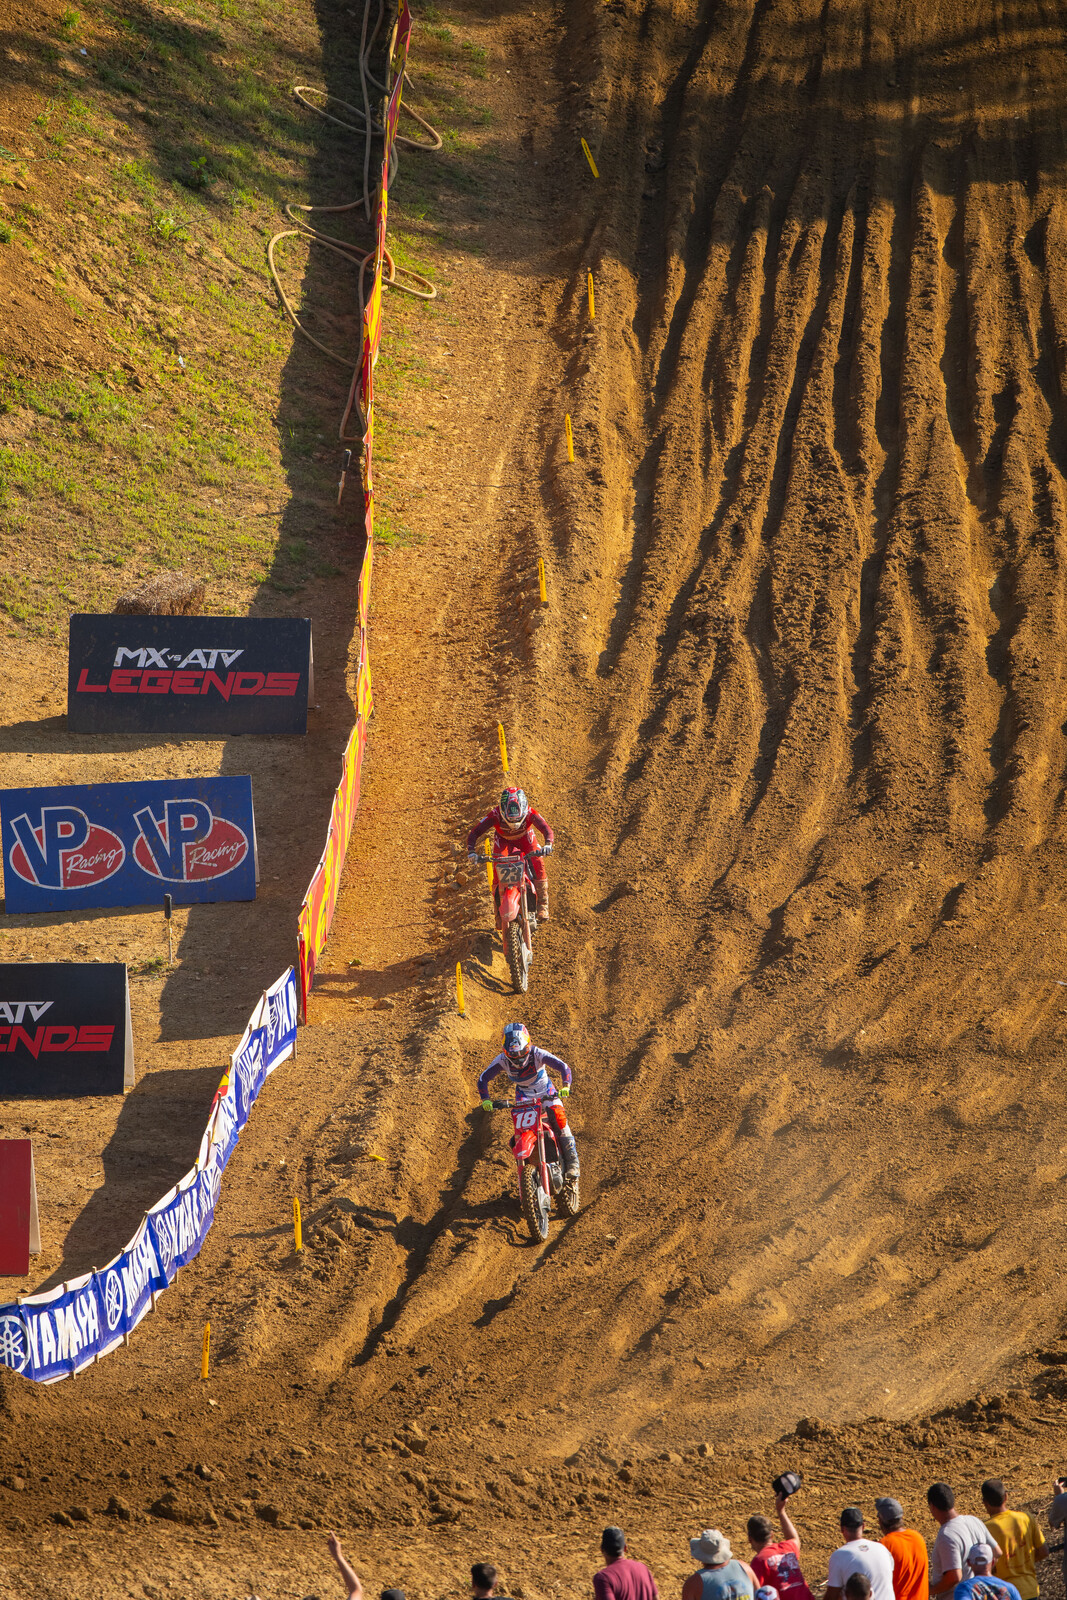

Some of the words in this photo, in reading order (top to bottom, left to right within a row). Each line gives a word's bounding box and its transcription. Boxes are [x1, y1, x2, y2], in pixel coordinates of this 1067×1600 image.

[113, 647, 170, 668] MX
[177, 648, 245, 669] ATV
[76, 668, 300, 702] LEGENDS
[9, 805, 91, 889] VP
[133, 799, 214, 881] VP
[66, 848, 123, 879] Racing
[189, 841, 247, 872] Racing
[515, 1110, 538, 1129] 18
